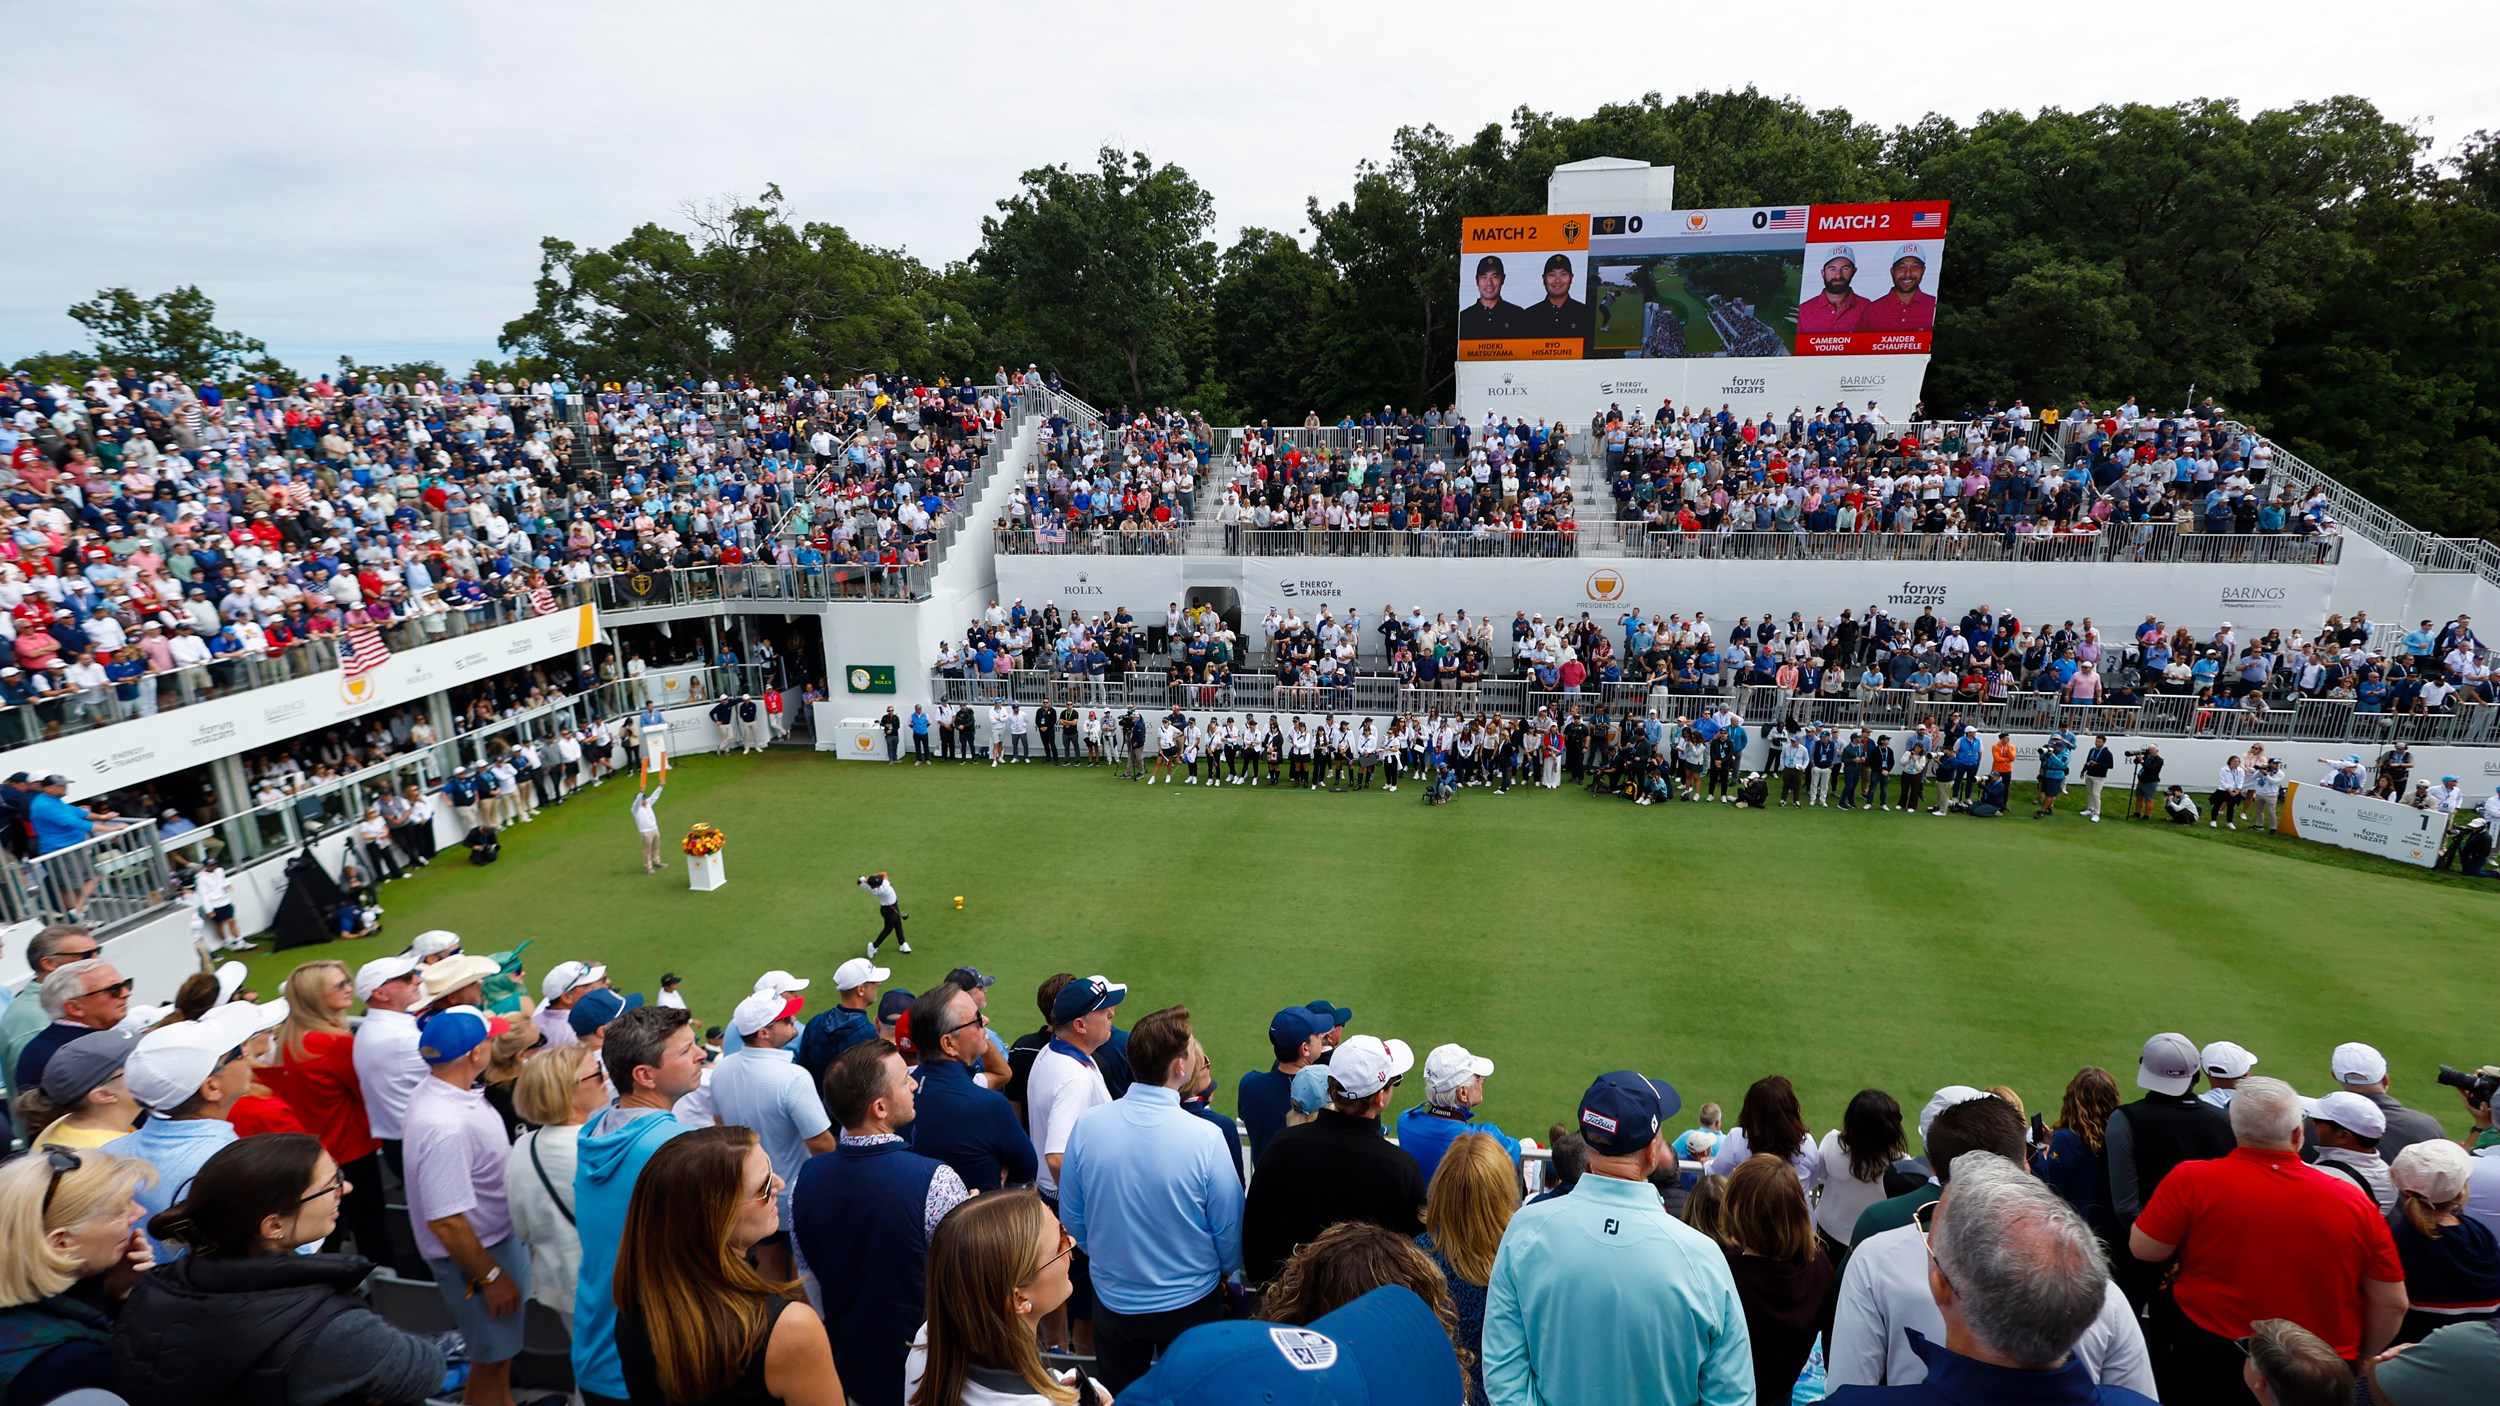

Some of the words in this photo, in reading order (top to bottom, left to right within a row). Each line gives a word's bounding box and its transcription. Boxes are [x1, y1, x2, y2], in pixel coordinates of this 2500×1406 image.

[1628, 215, 1643, 233] 0
[1752, 211, 1767, 229] 0
[1818, 215, 1876, 230] MATCH
[1879, 214, 1890, 228] 2
[1472, 227, 1524, 241] MATCH
[1528, 227, 1537, 239] 2
[1833, 247, 1848, 255] USA
[1903, 245, 1918, 253] USA
[1881, 335, 1916, 343] XANDER
[1732, 376, 1765, 386] forvis
[1840, 375, 1886, 385] BARINGS
[1488, 387, 1528, 396] ROLEX
[1721, 386, 1765, 394] mazars
[1300, 580, 1333, 588] ENERGY
[1902, 581, 1947, 595] forvis
[1064, 586, 1103, 595] ROLEX
[2221, 587, 2286, 599] BARINGS
[1888, 595, 1945, 605] mazars
[2307, 803, 2336, 815] ROLEX
[2357, 808, 2393, 822] BARINGS
[2312, 819, 2334, 827] ENERGY
[2420, 814, 2430, 831] 1
[2311, 823, 2338, 833] TRANSFER
[2353, 832, 2387, 845] mazars
[2362, 828, 2388, 840] forvis
[2401, 839, 2420, 847] METERS
[1431, 1107, 1451, 1117] Canon
[1585, 1113, 1614, 1131] Titleist
[1603, 1218, 1620, 1236] FJ
